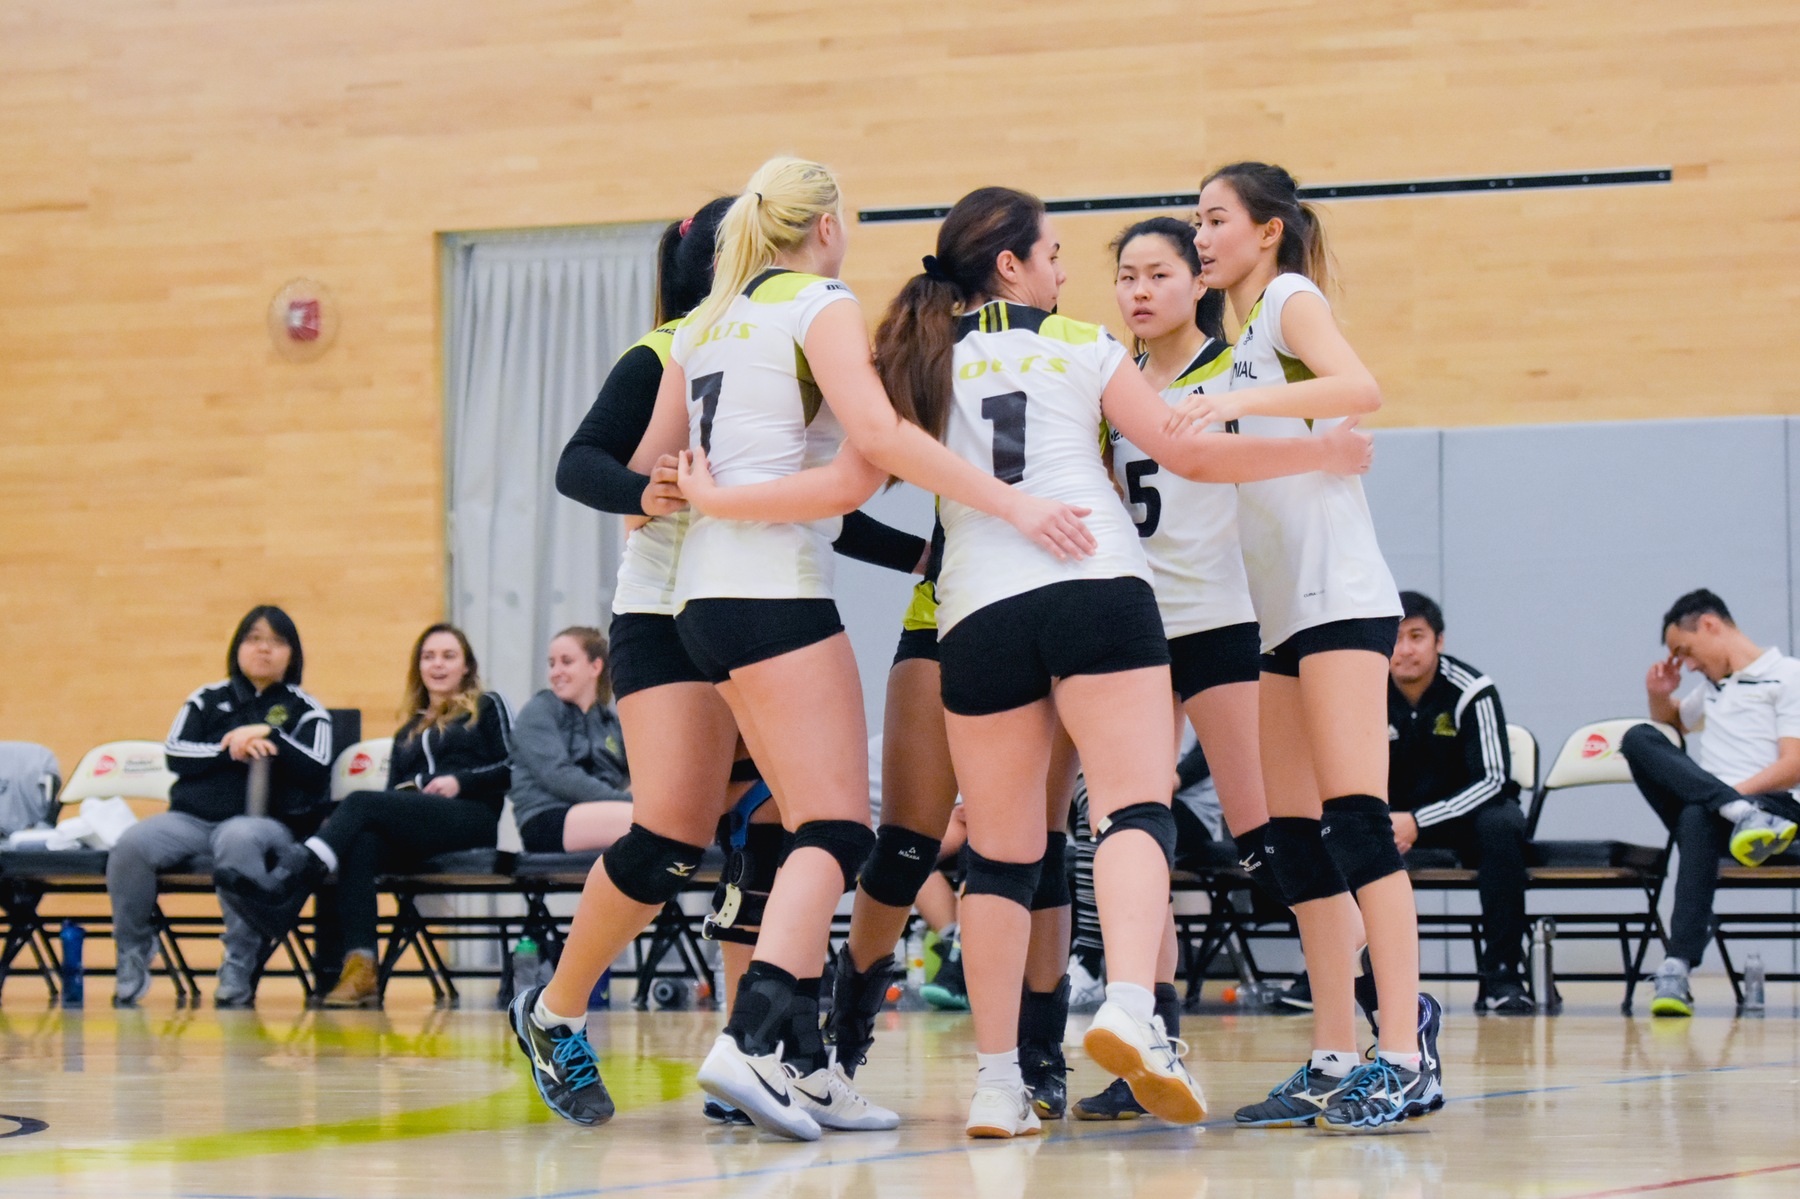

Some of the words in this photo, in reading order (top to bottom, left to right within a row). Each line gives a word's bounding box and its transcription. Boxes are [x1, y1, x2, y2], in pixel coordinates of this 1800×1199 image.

[691, 371, 724, 459] 7
[981, 390, 1027, 485] 1
[1126, 459, 1162, 538] 5
